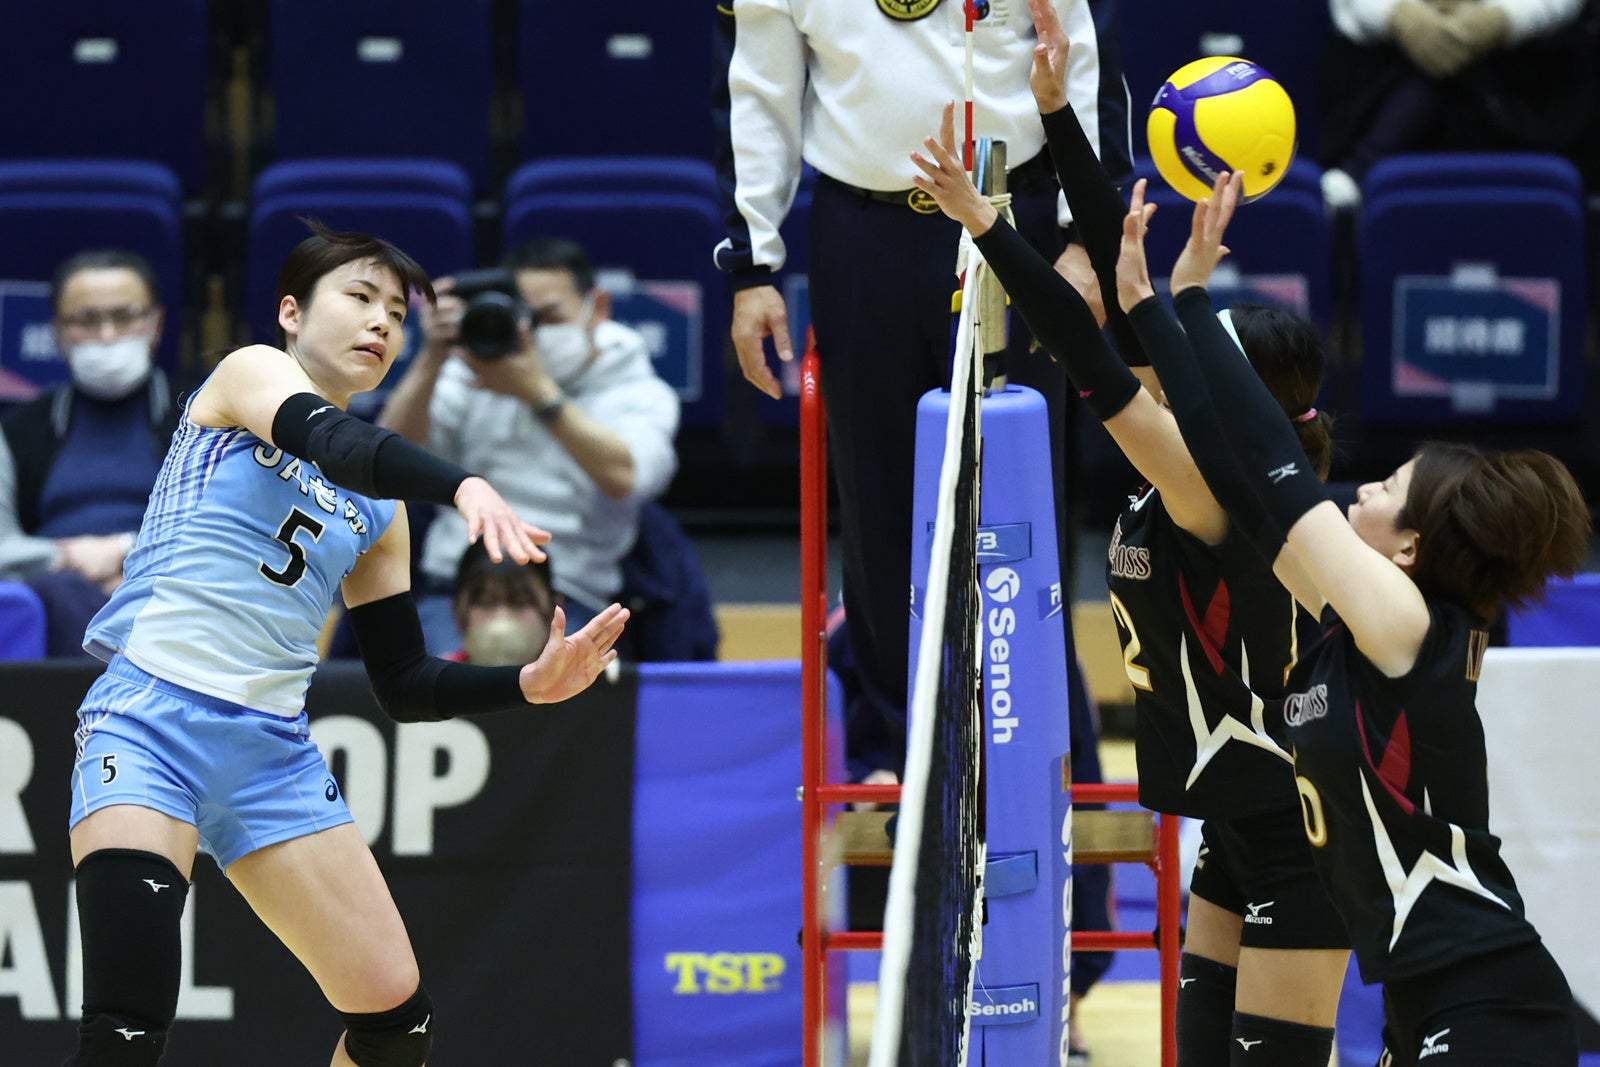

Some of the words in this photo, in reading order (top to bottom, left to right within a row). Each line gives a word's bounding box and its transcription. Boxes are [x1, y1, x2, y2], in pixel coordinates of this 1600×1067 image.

[257, 505, 326, 588] 5
[988, 607, 1019, 744] Senoh
[100, 753, 118, 786] 5
[665, 952, 786, 995] TSP
[969, 999, 1036, 1016] Senoh
